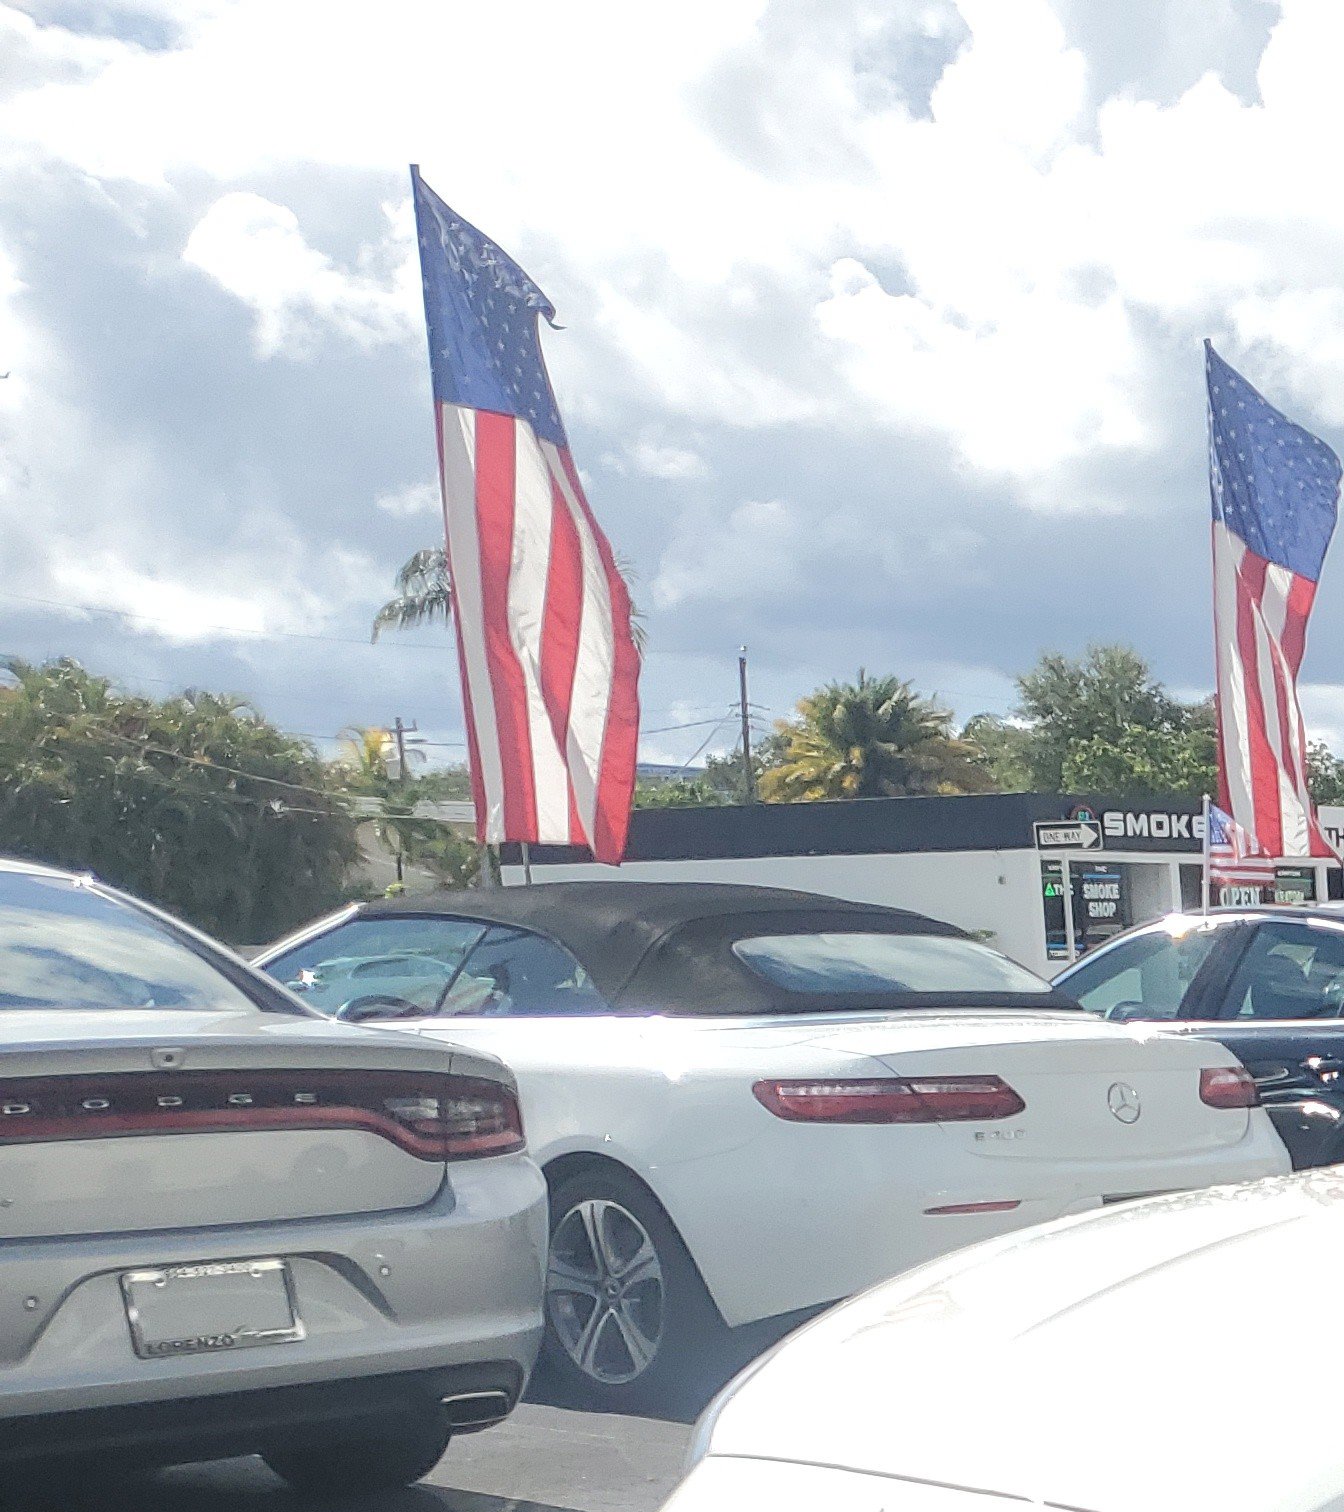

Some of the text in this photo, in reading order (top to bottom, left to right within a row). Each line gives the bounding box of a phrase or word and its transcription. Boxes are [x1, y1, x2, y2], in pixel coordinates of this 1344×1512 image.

[1103, 811, 1205, 839] SMOKE
[1042, 830, 1082, 844] ONE WAY
[1082, 883, 1121, 900] SMOKE
[1219, 886, 1261, 907] OPEN
[1088, 901, 1117, 918] SHOP
[2, 1093, 318, 1115] DODGE
